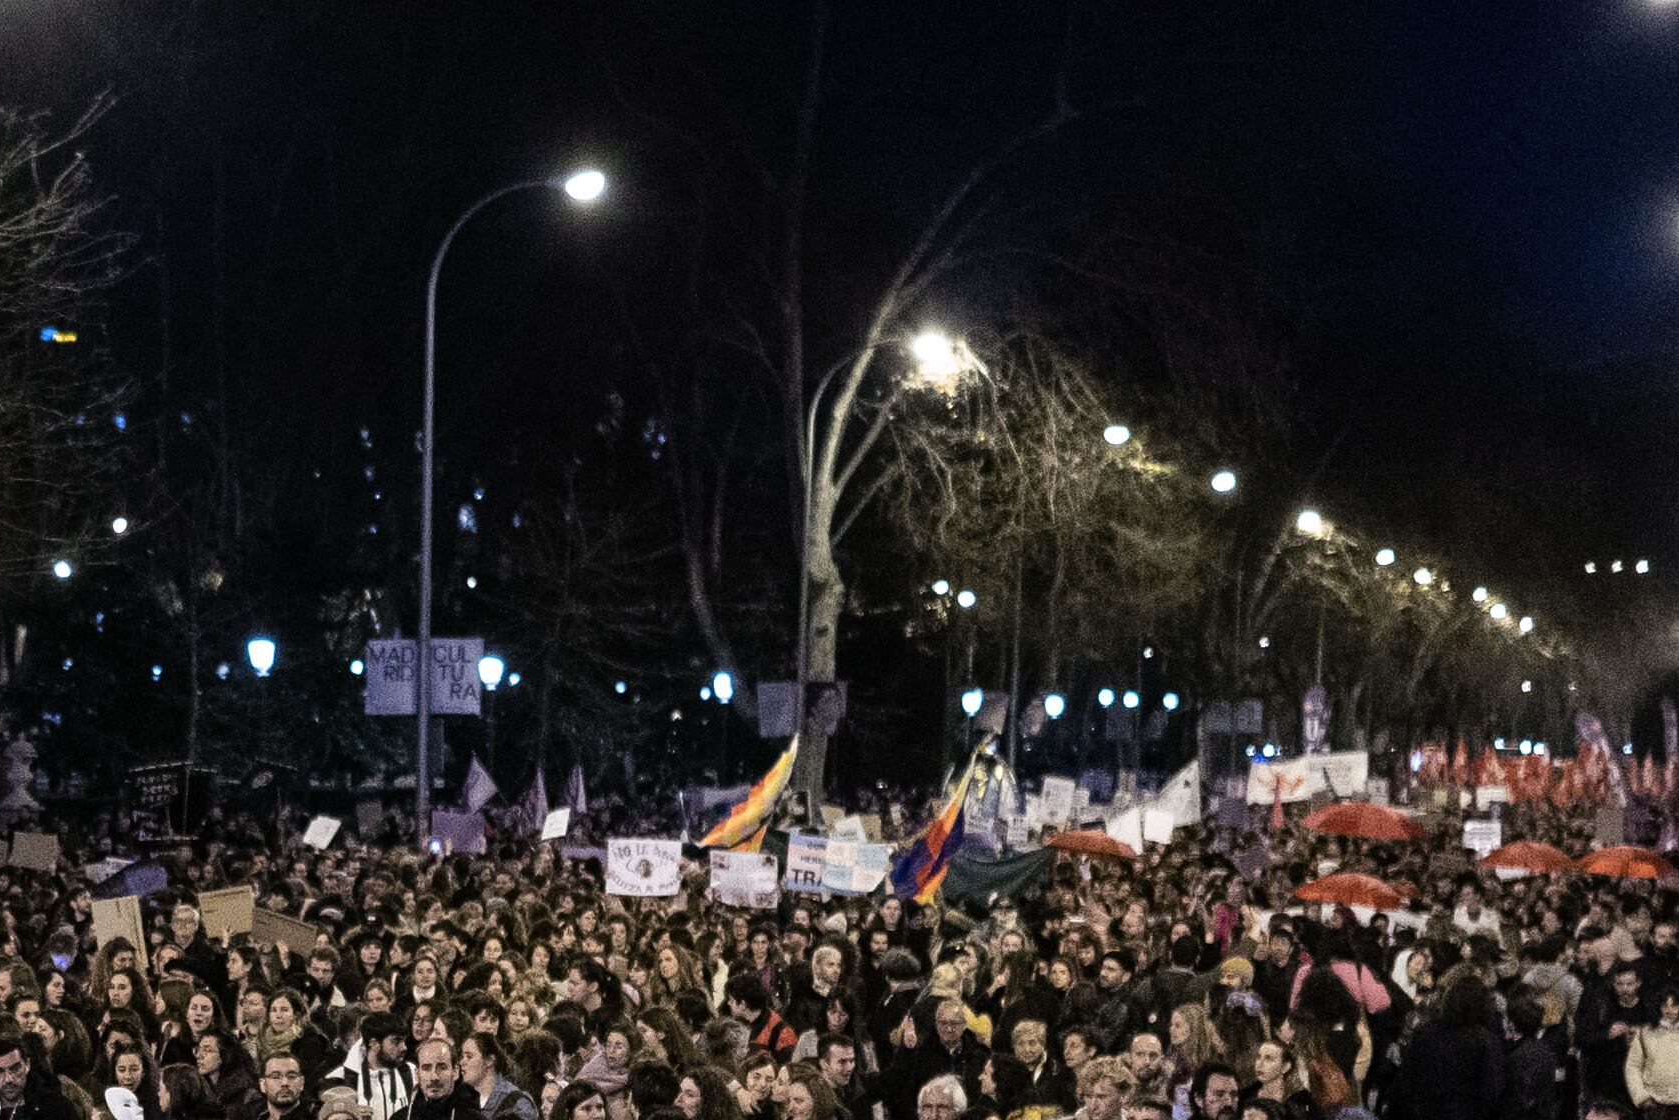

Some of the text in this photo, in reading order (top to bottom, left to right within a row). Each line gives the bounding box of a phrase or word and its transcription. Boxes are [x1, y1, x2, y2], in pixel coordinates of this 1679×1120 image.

[433, 645, 472, 664] CUL
[438, 664, 464, 682] TU
[450, 682, 478, 700] RA
